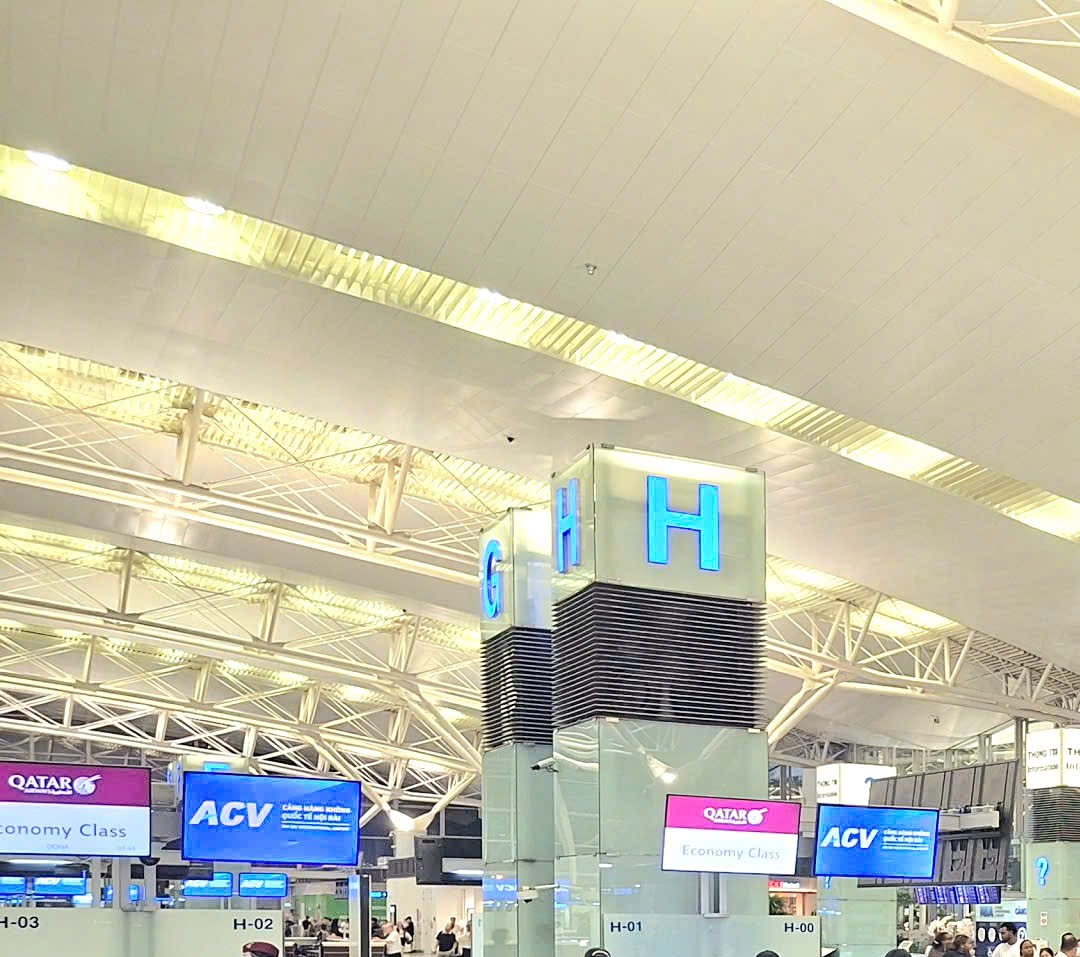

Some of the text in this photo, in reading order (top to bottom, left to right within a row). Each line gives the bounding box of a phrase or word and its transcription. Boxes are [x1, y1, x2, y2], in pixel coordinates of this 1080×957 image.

[556, 478, 578, 573] H
[647, 475, 720, 571] H
[481, 539, 503, 618] G
[8, 774, 73, 791] QATAR
[189, 800, 274, 828] ACV
[704, 808, 747, 821] QATAR
[0, 823, 127, 839] onomy Class
[820, 827, 878, 849] ACV
[682, 844, 781, 860] Economy Class
[0, 916, 40, 929] H-03
[233, 918, 273, 930] H-02
[610, 921, 642, 932] H-01
[784, 922, 814, 933] H-00
